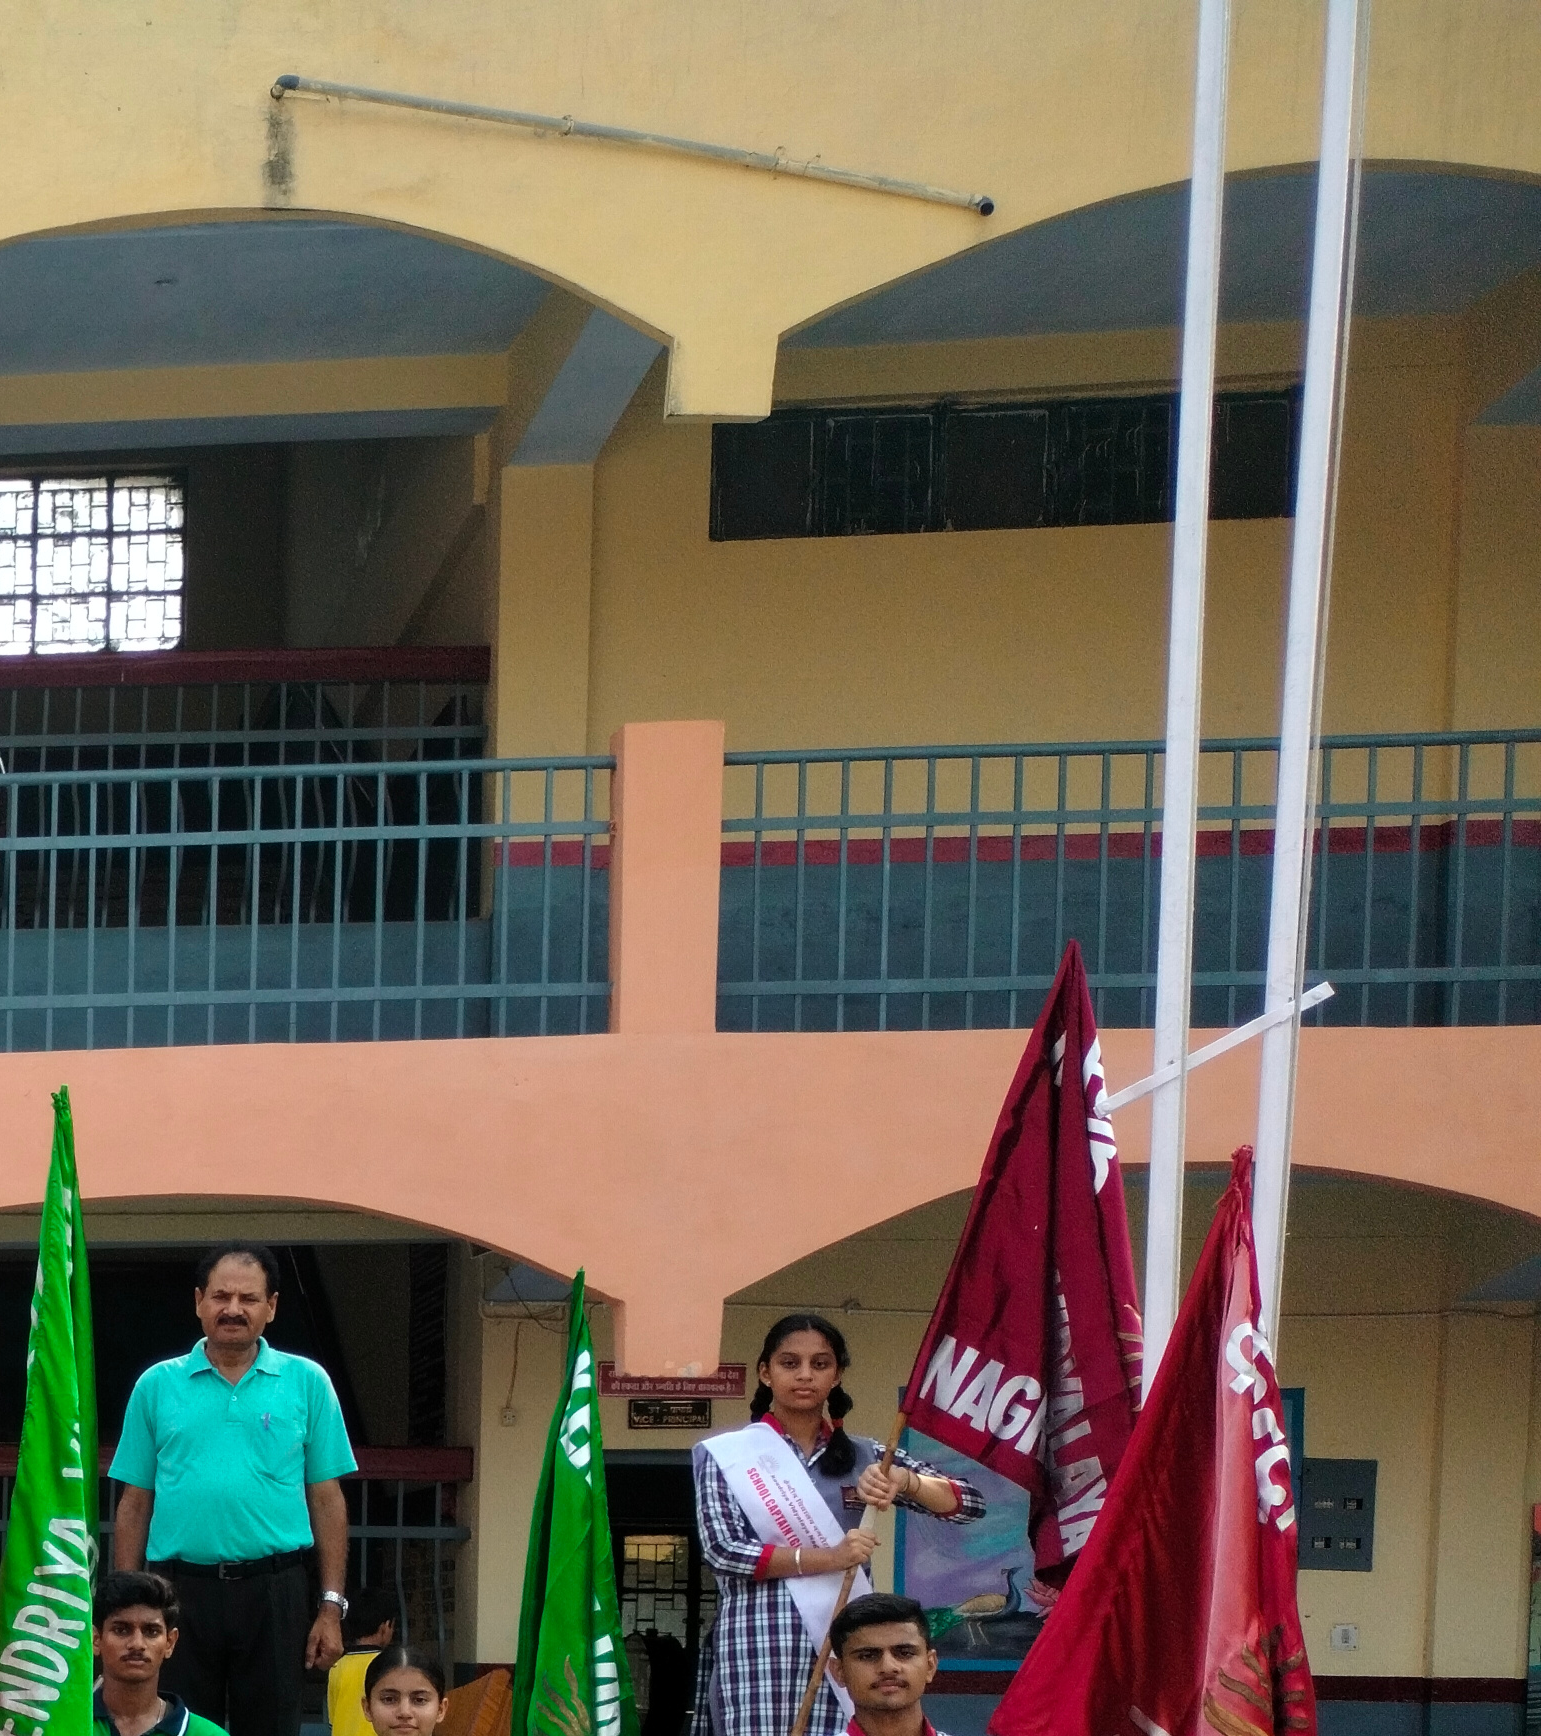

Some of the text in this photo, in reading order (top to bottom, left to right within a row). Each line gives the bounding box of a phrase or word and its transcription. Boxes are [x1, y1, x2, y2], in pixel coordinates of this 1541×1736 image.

[633, 1415, 655, 1424] VICE
[662, 1414, 708, 1424] PRINCIPAL
[747, 1467, 794, 1537] SCHOOL CAPTAIN
